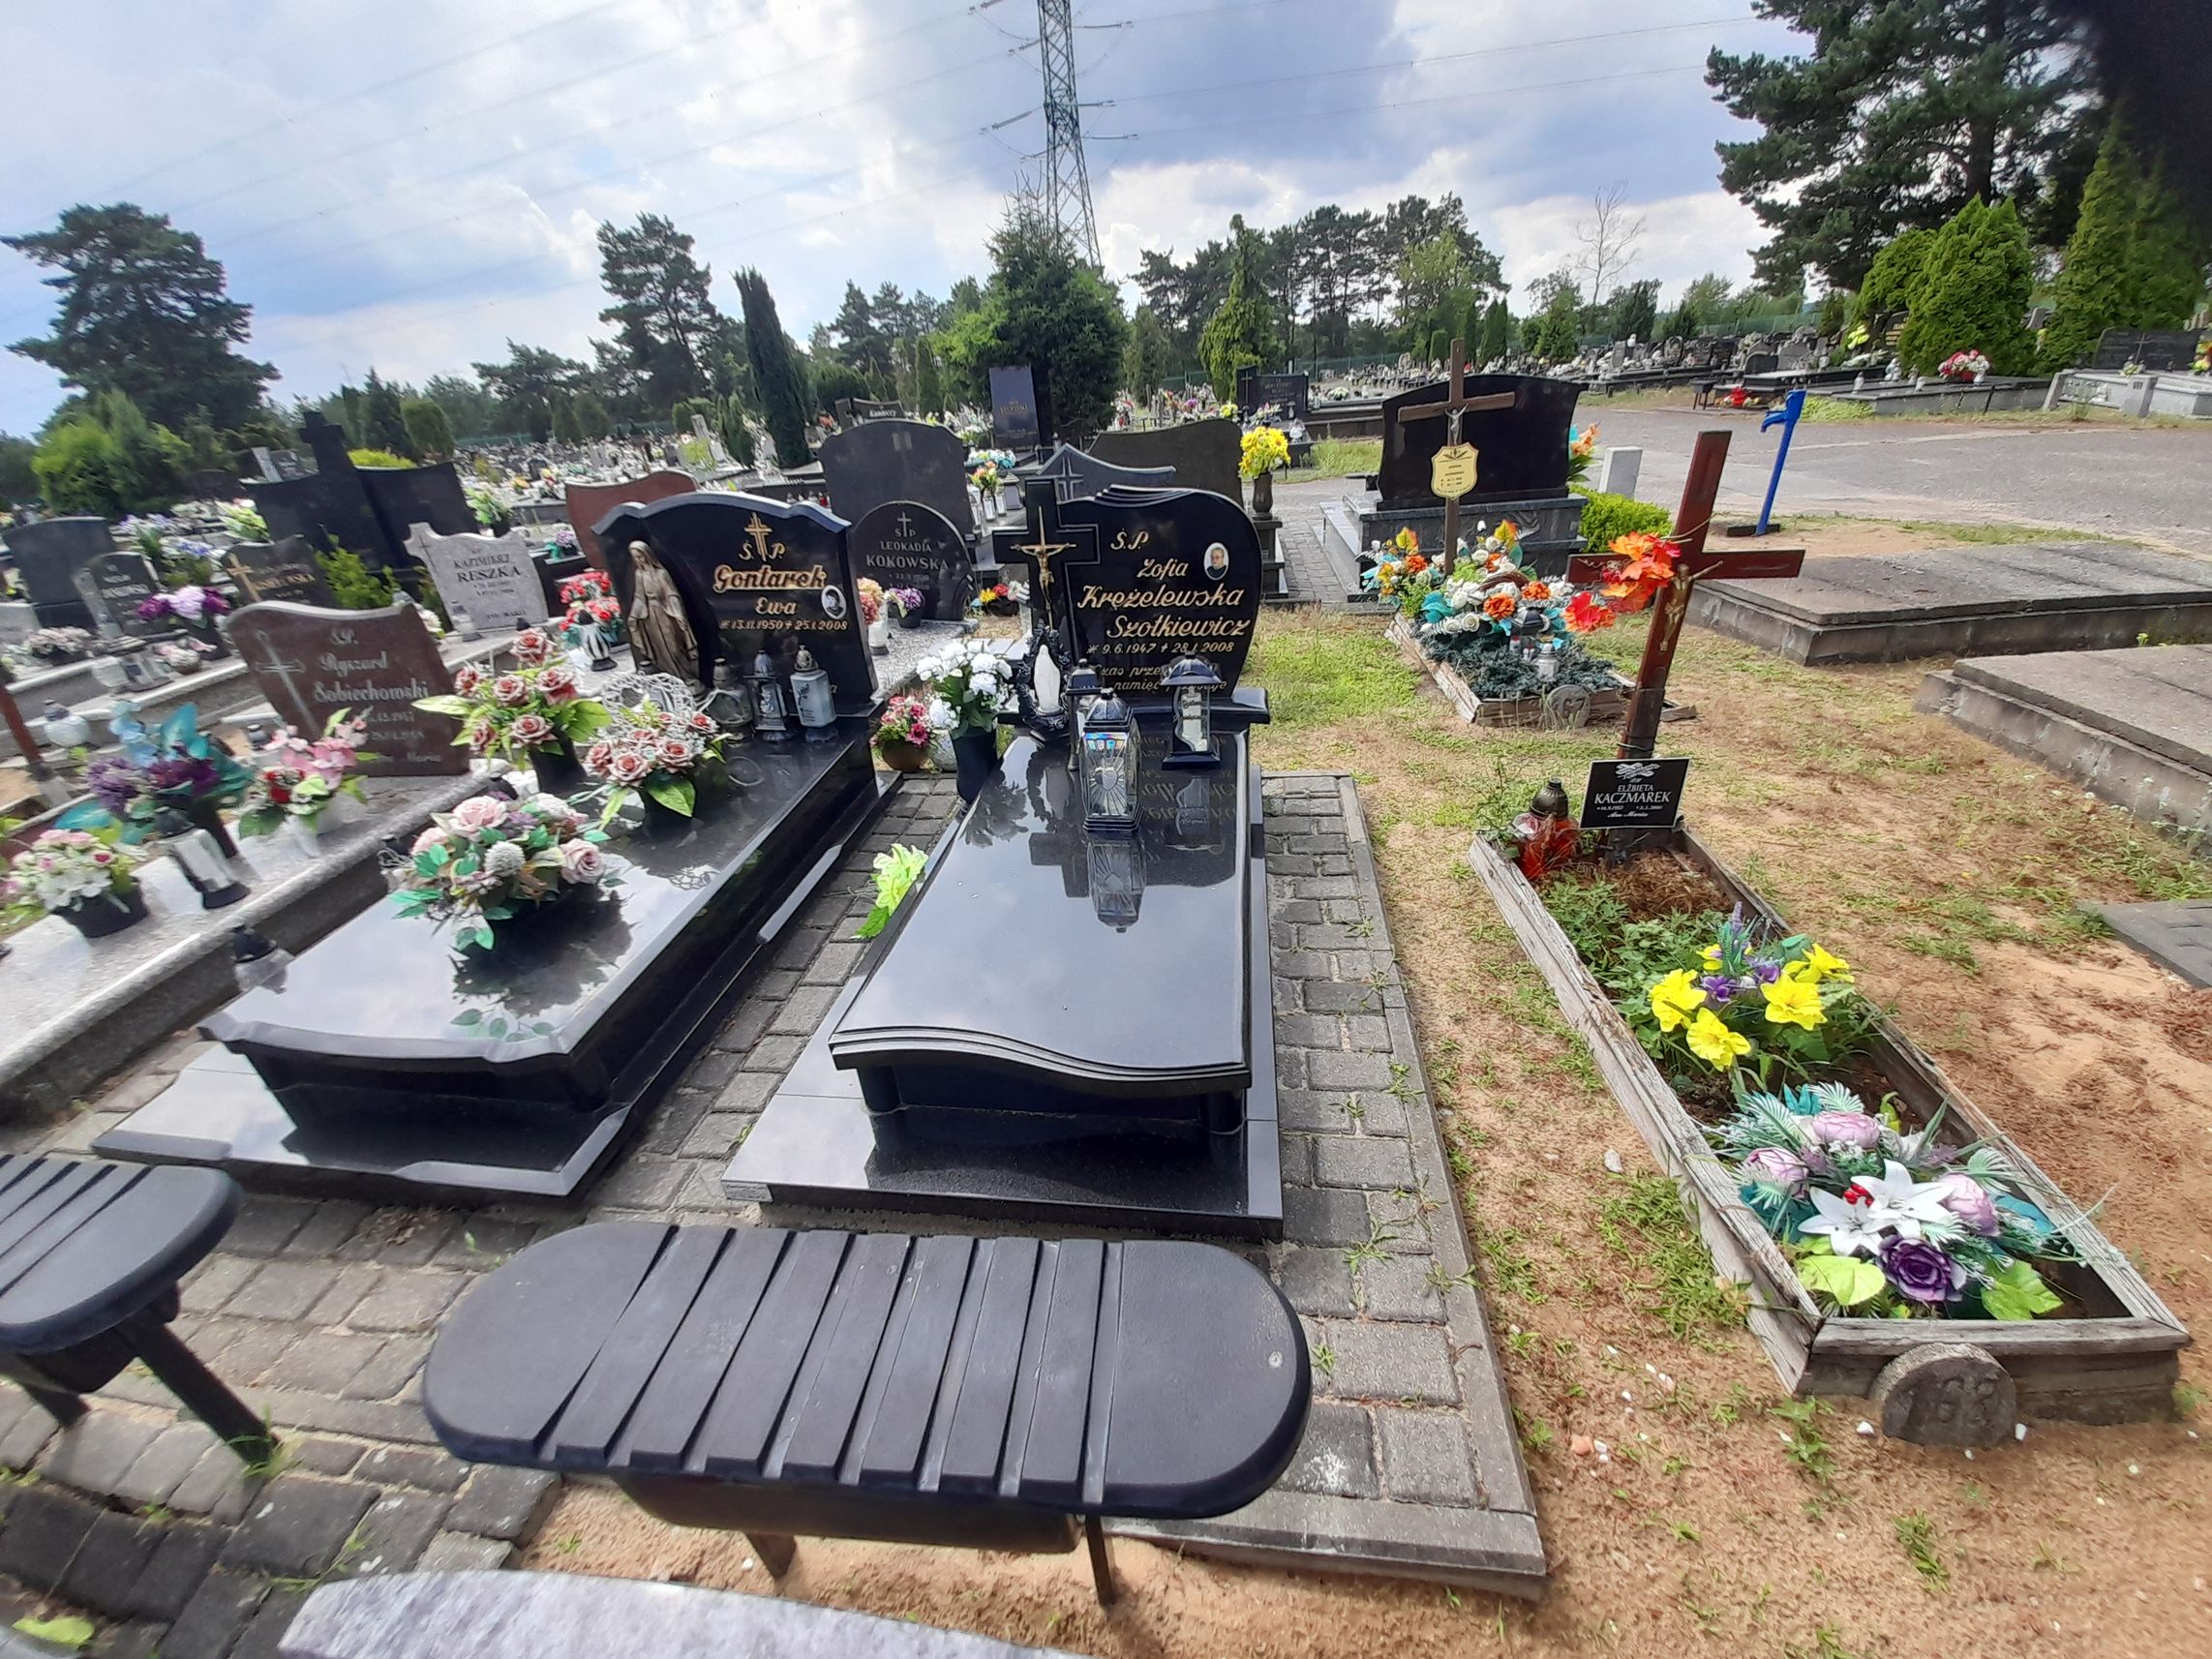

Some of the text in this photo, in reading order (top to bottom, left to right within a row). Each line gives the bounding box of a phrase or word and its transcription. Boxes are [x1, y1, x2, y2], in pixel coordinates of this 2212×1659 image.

[880, 540, 932, 552] LEOKADIA
[865, 554, 949, 570] KOKOWSKA
[1136, 558, 1190, 581] Zofia
[712, 563, 828, 593] Gontarek
[754, 596, 798, 616] Ewa
[1594, 791, 1672, 804] KACZMAREK
